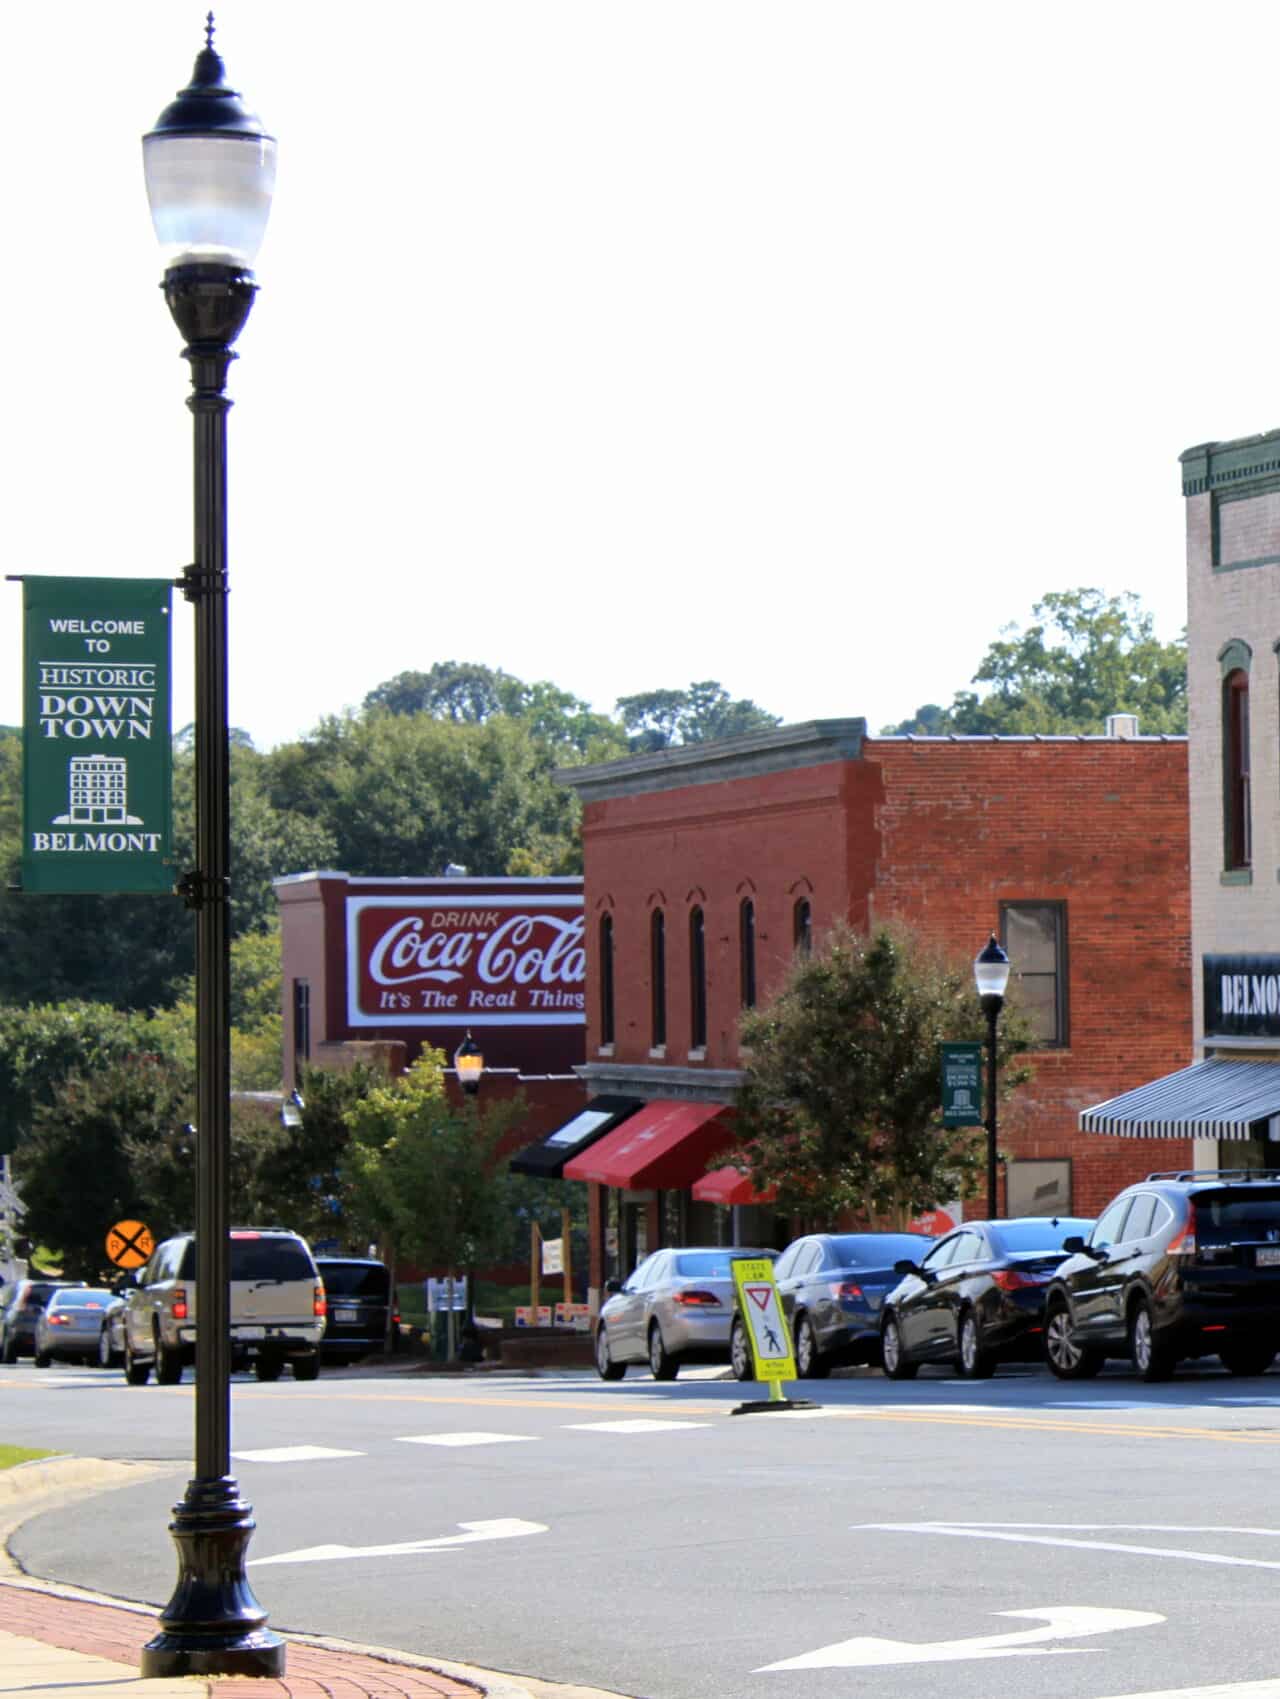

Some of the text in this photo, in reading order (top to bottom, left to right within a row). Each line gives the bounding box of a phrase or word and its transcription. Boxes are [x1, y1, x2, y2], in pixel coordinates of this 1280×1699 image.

[50, 619, 145, 635] WELCOME
[85, 639, 110, 653] TO
[40, 668, 155, 687] HISTORIC
[40, 695, 153, 718] DOWN
[40, 718, 152, 739] TOWN
[33, 833, 161, 852] BELMONT
[431, 911, 501, 928] DRINK
[369, 915, 585, 985] Coca-Cola
[380, 989, 585, 1009] It's The Real Thing
